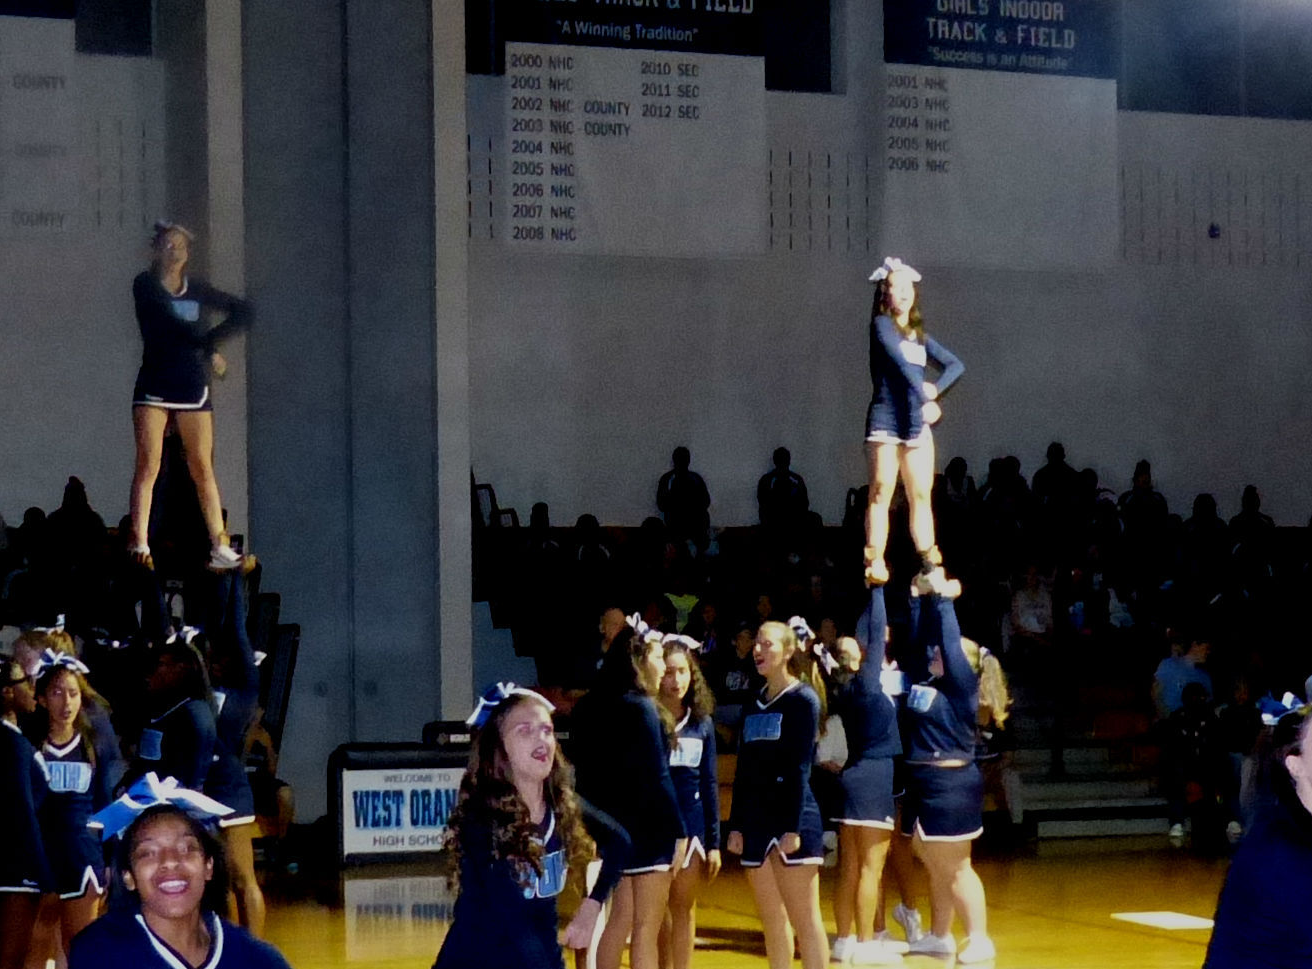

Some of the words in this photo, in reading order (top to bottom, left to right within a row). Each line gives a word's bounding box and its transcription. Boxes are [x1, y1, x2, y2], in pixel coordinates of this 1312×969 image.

[1000, 0, 1064, 21] INDOOR
[575, 21, 631, 40] Winning
[927, 17, 987, 41] TRACK
[994, 28, 1008, 44] &
[1017, 25, 1075, 49] FIELD
[512, 53, 543, 68] 2000
[550, 56, 574, 70] NHC
[641, 61, 671, 75] 2010
[677, 63, 699, 77] SEC
[512, 75, 543, 89] 2001
[550, 78, 574, 91] NHC
[641, 83, 671, 97] 2011
[677, 84, 700, 98] SEC
[887, 75, 919, 89] 2001
[925, 77, 949, 91] NHC
[512, 97, 543, 111] 2002
[550, 98, 574, 112] NHC
[584, 100, 630, 116] COUNTY
[642, 104, 672, 118] 2012
[678, 105, 700, 119] SEC
[925, 97, 949, 111] NHC
[550, 120, 574, 134] NHC
[584, 121, 630, 136] COUNTY
[887, 116, 919, 130] 2004
[925, 118, 949, 132] NHC
[512, 140, 543, 154] 2004
[550, 142, 574, 155] NHC
[925, 138, 949, 152] NHC
[512, 161, 543, 176] 2005
[550, 163, 574, 177] NHC
[925, 158, 949, 173] NHC
[512, 183, 543, 197] 2006
[550, 184, 574, 198] NHC
[512, 204, 543, 218] 2007
[550, 206, 574, 219] NHC
[550, 228, 574, 241] NHC
[384, 773, 432, 783] WELCOME
[437, 773, 450, 782] TO
[352, 789, 404, 828] WEST
[373, 835, 404, 846] HIGH
